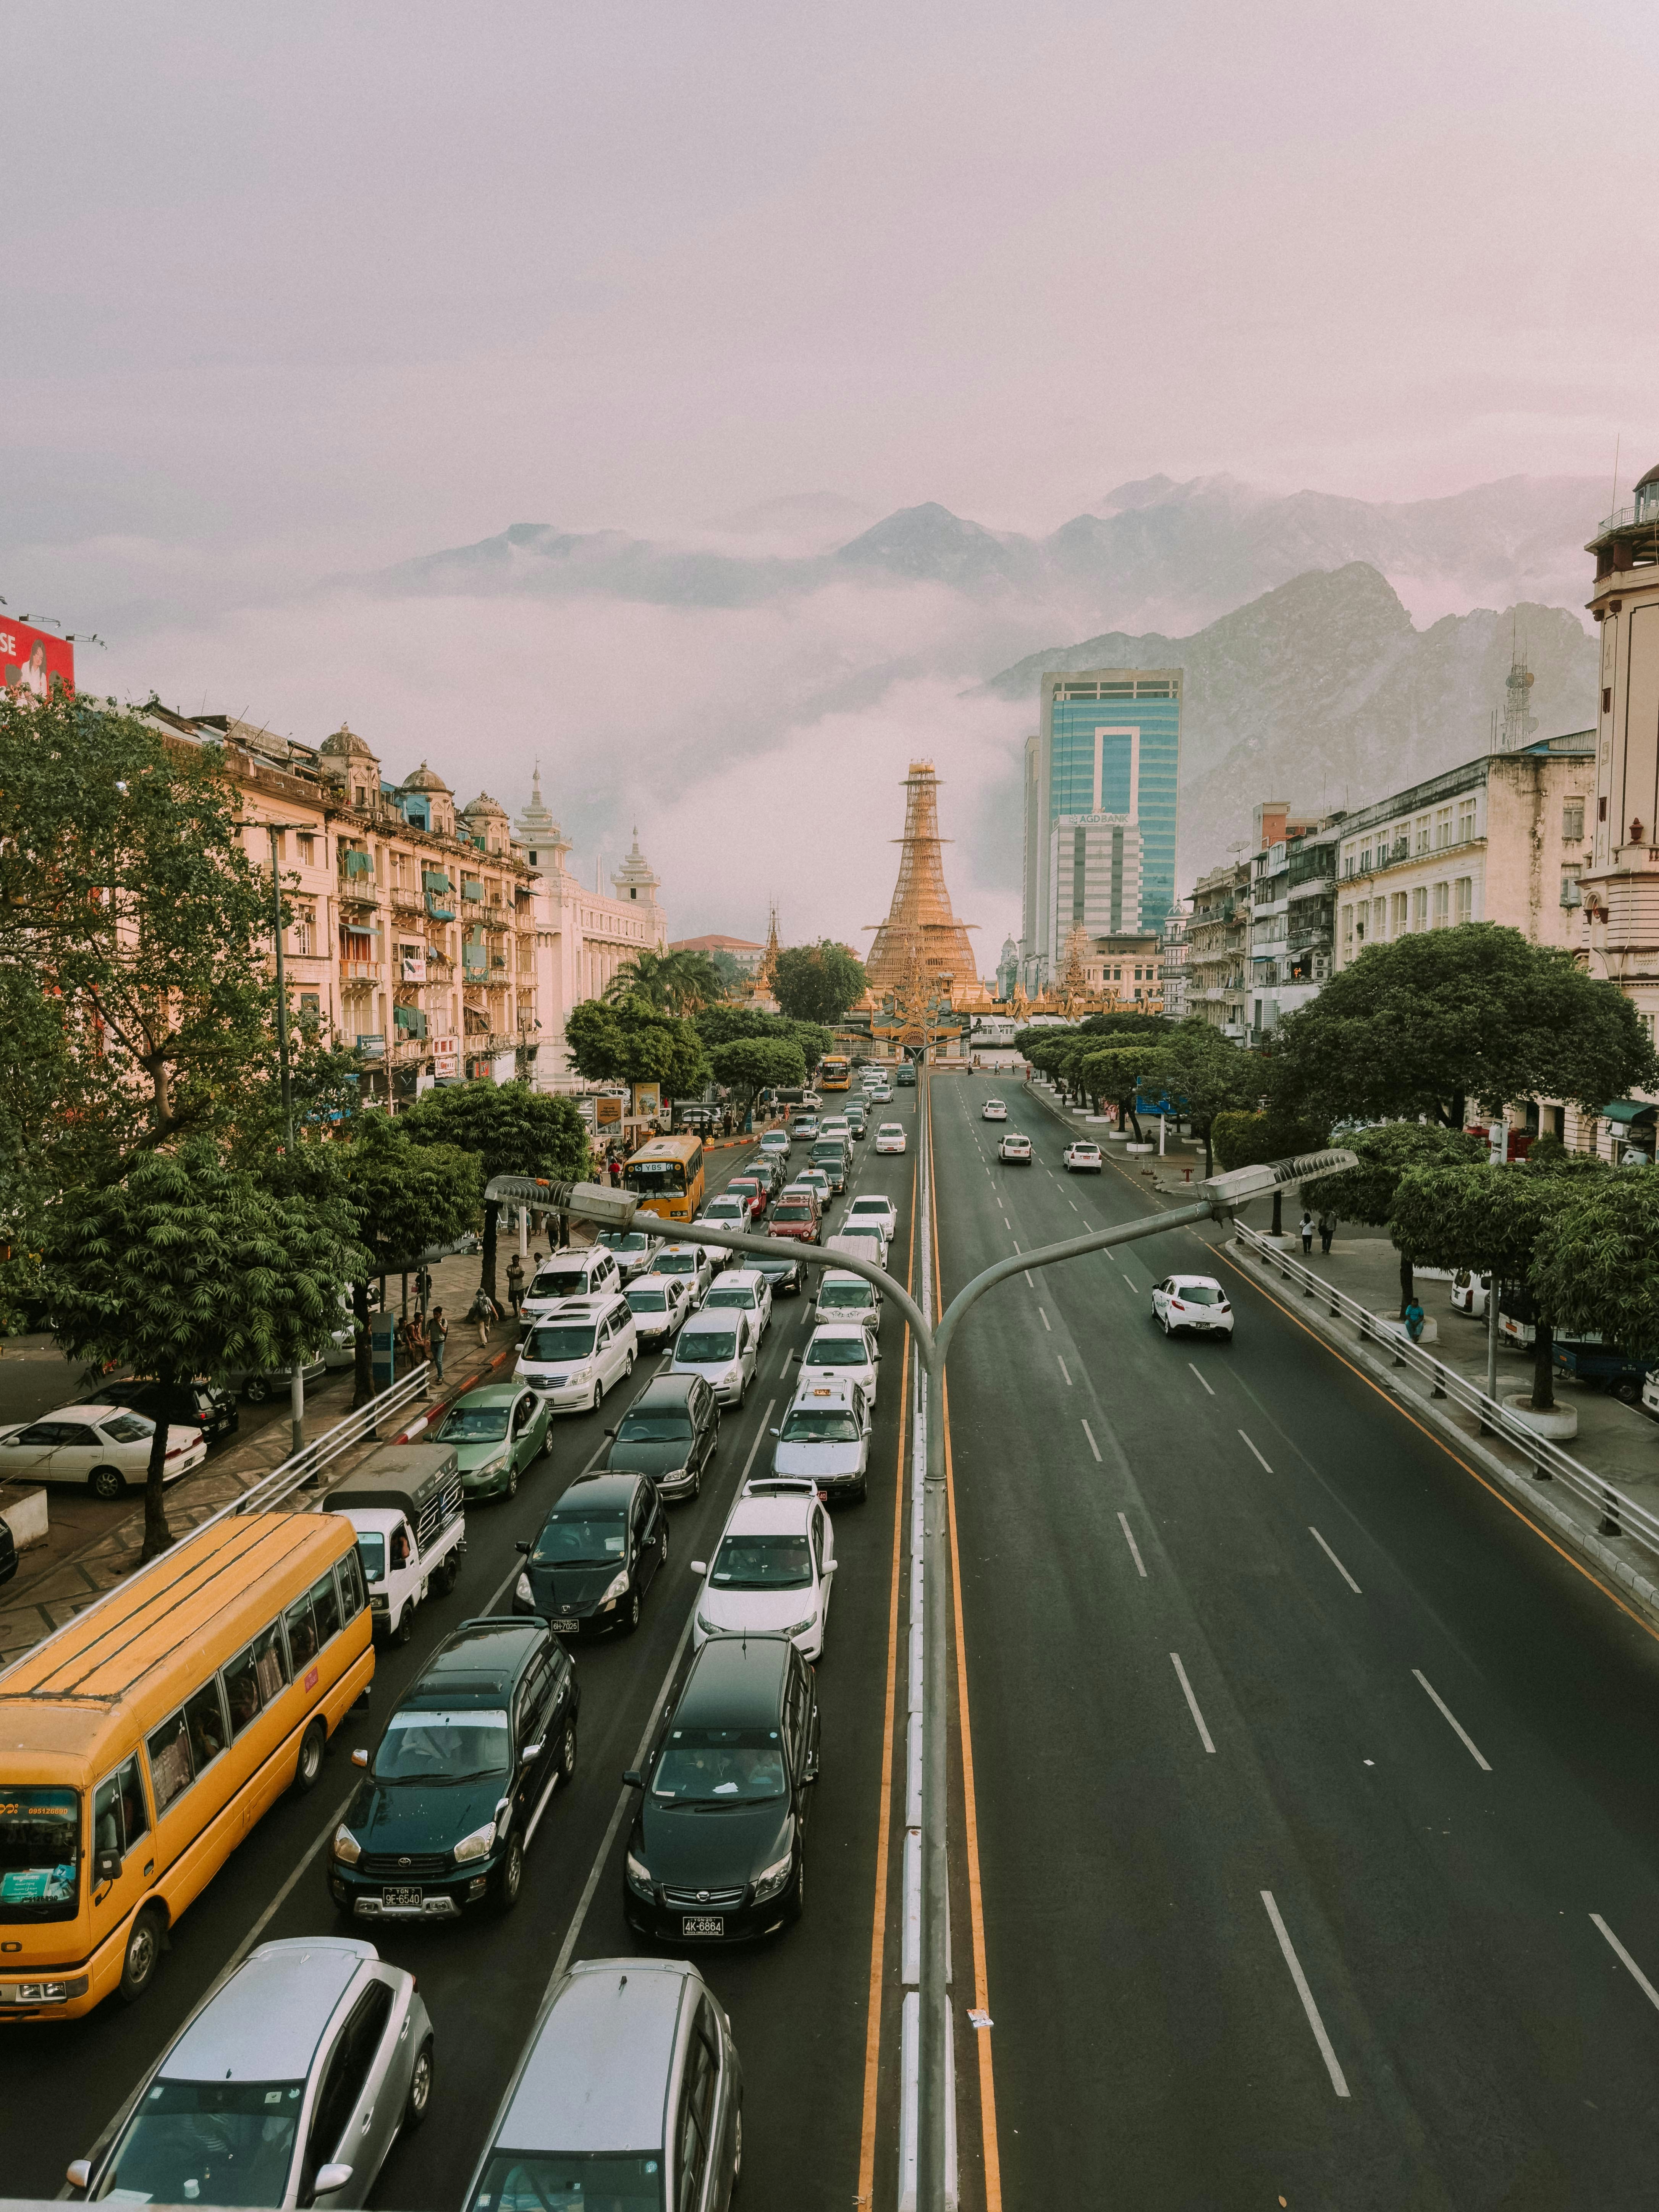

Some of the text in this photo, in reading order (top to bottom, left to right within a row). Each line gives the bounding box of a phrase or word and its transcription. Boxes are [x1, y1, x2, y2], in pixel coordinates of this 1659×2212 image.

[0, 632, 16, 656] SE
[1080, 815, 1129, 823] AGD BANK
[386, 1894, 420, 1904] 9E-6540
[685, 1922, 721, 1931] 4K-6864
